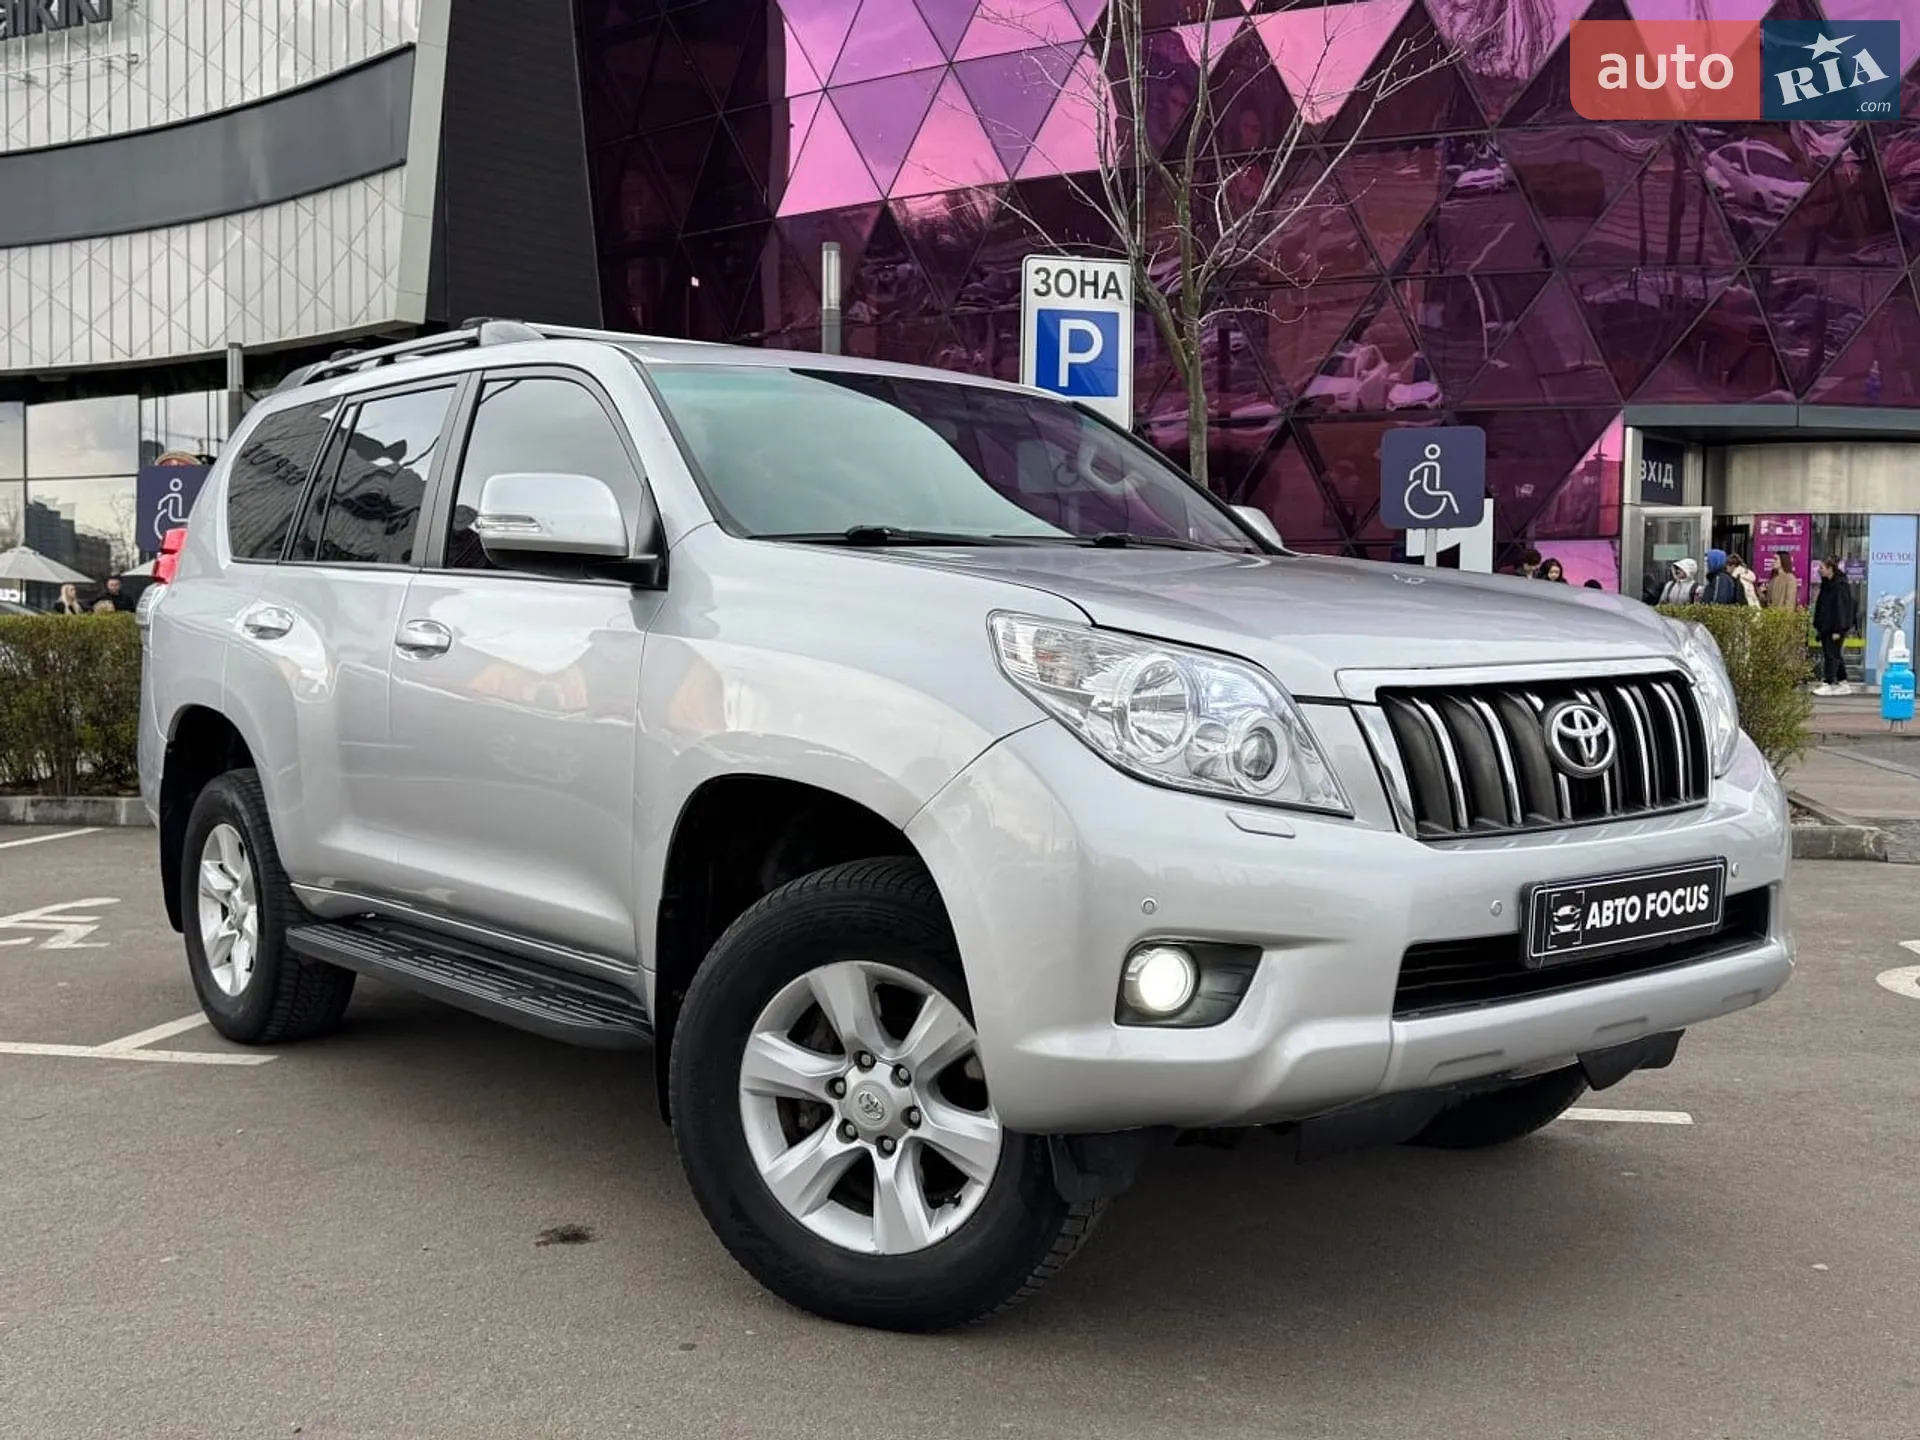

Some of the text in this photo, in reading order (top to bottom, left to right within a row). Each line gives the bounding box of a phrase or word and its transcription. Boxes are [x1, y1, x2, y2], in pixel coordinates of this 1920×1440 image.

[1033, 266, 1124, 300] ЗОНА
[1058, 318, 1104, 388] P
[1645, 883, 1710, 920] FOCUS
